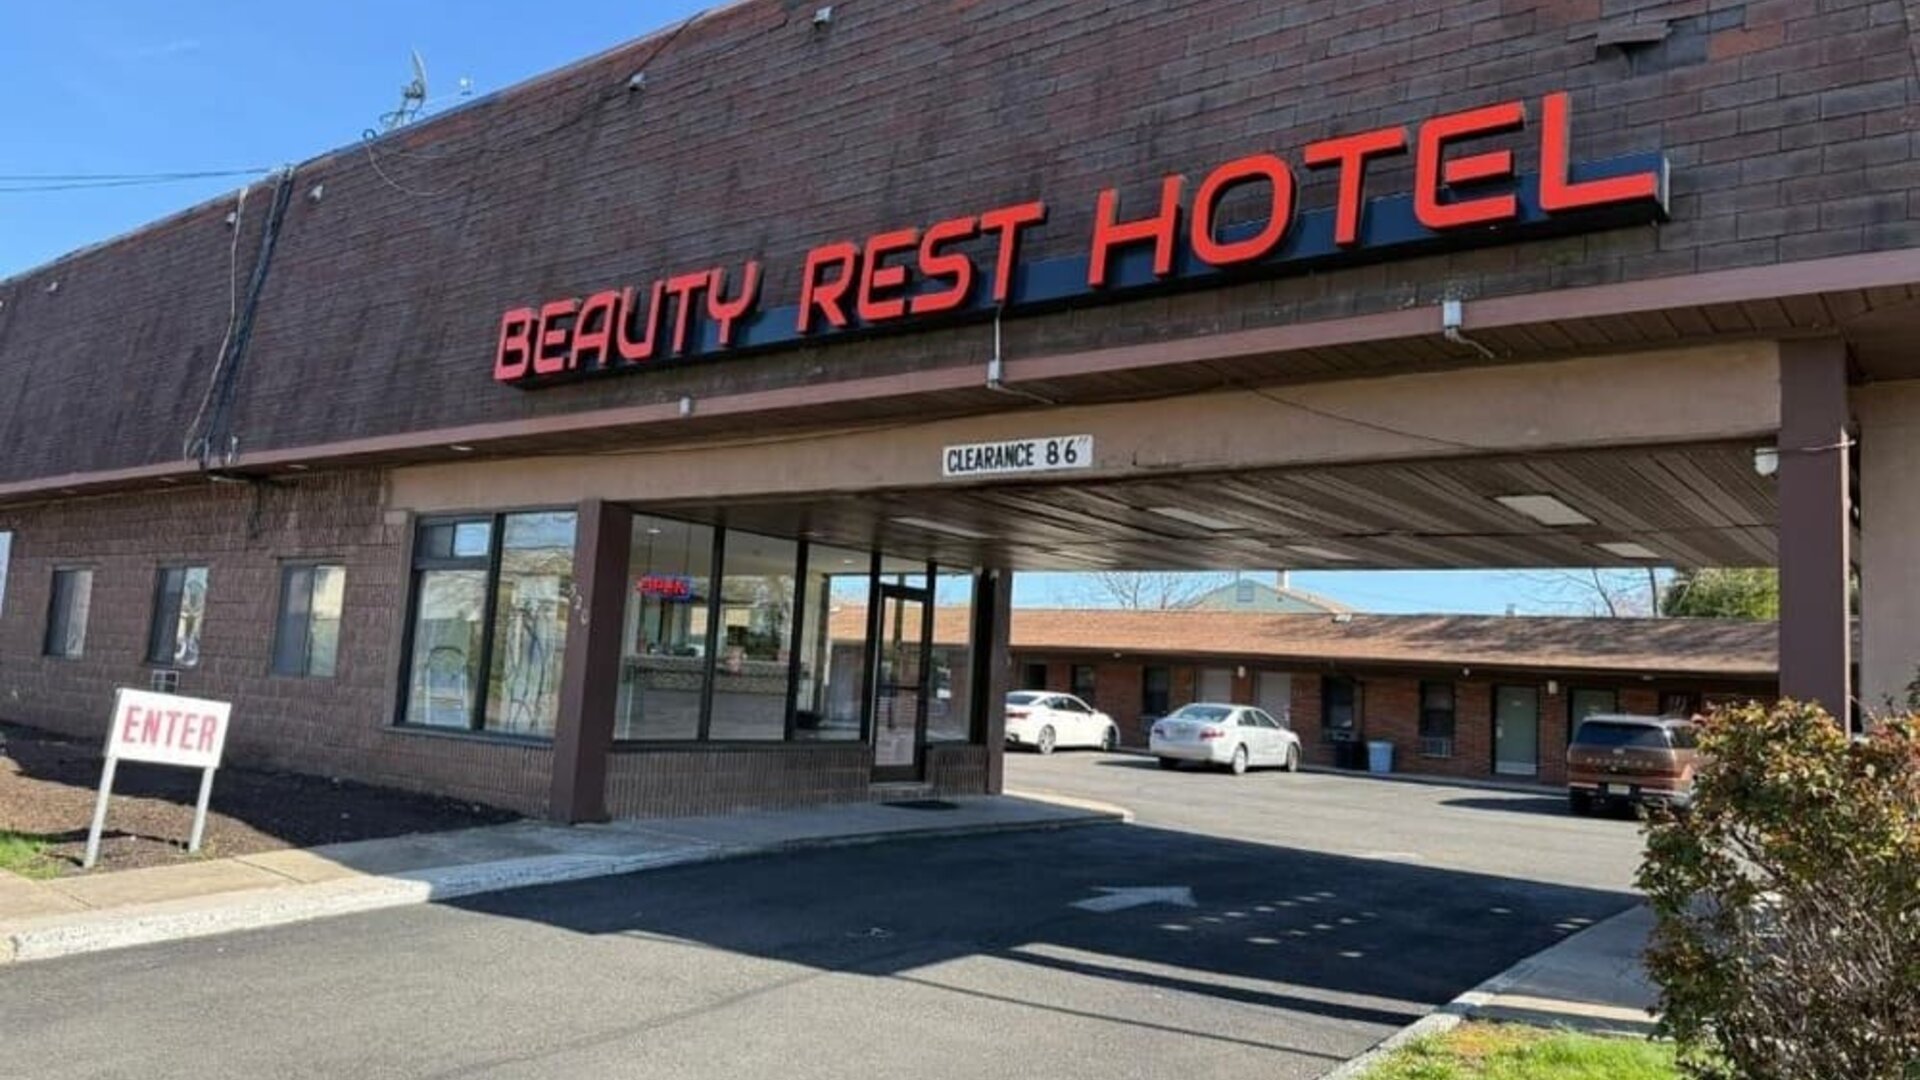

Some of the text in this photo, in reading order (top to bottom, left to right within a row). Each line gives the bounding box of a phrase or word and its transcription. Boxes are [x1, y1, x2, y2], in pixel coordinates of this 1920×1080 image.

[494, 93, 1656, 380] BEAUTY REST HOTEL
[947, 443, 1034, 472] CLEARANCE
[637, 576, 686, 596] OPEN
[122, 705, 217, 752] ENTER
